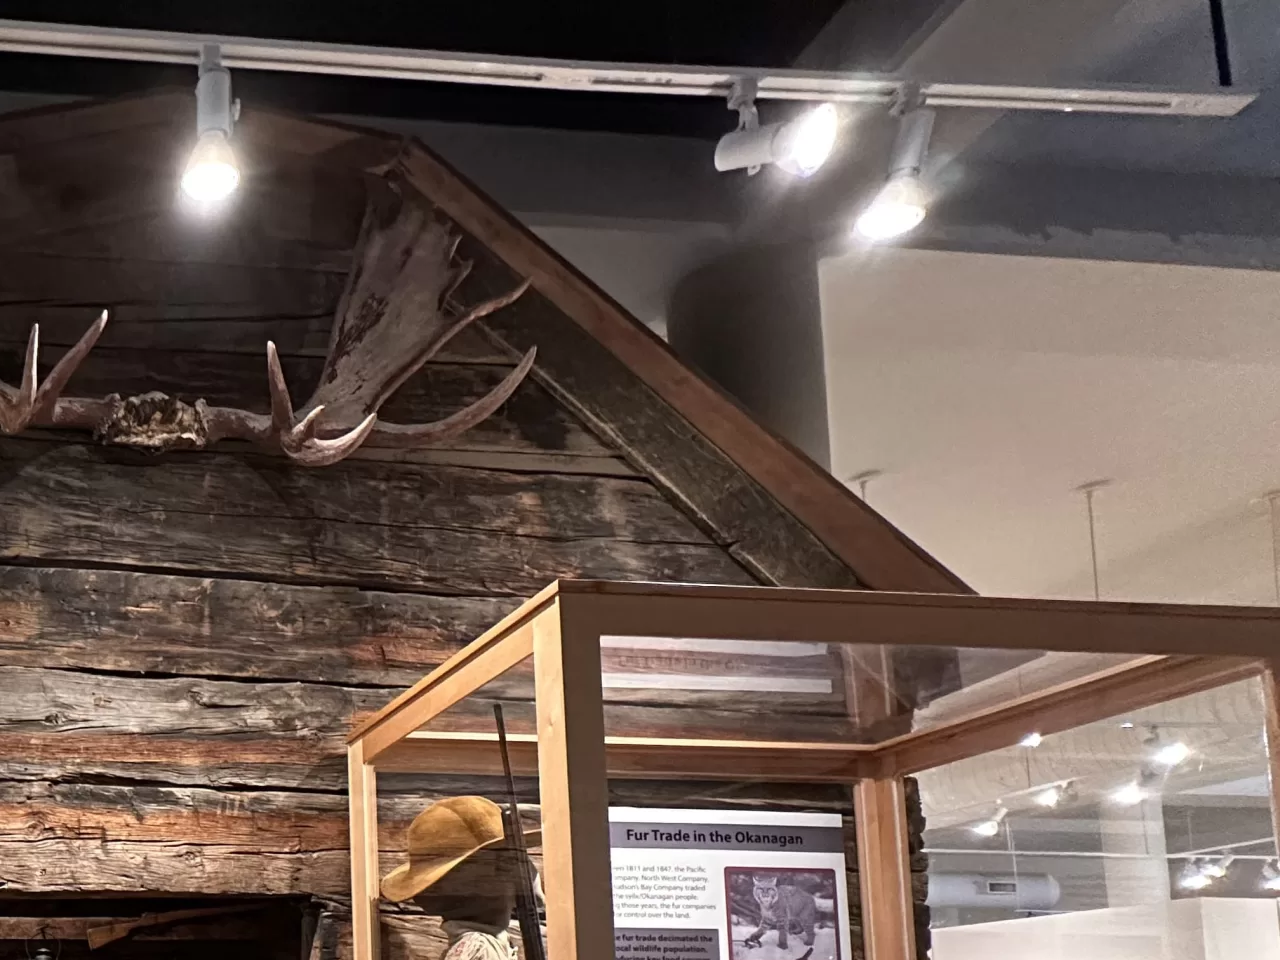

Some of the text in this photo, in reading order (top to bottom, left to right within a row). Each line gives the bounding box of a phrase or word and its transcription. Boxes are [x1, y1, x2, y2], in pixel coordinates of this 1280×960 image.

[627, 829, 803, 847] Fur Trade in the Okanagan
